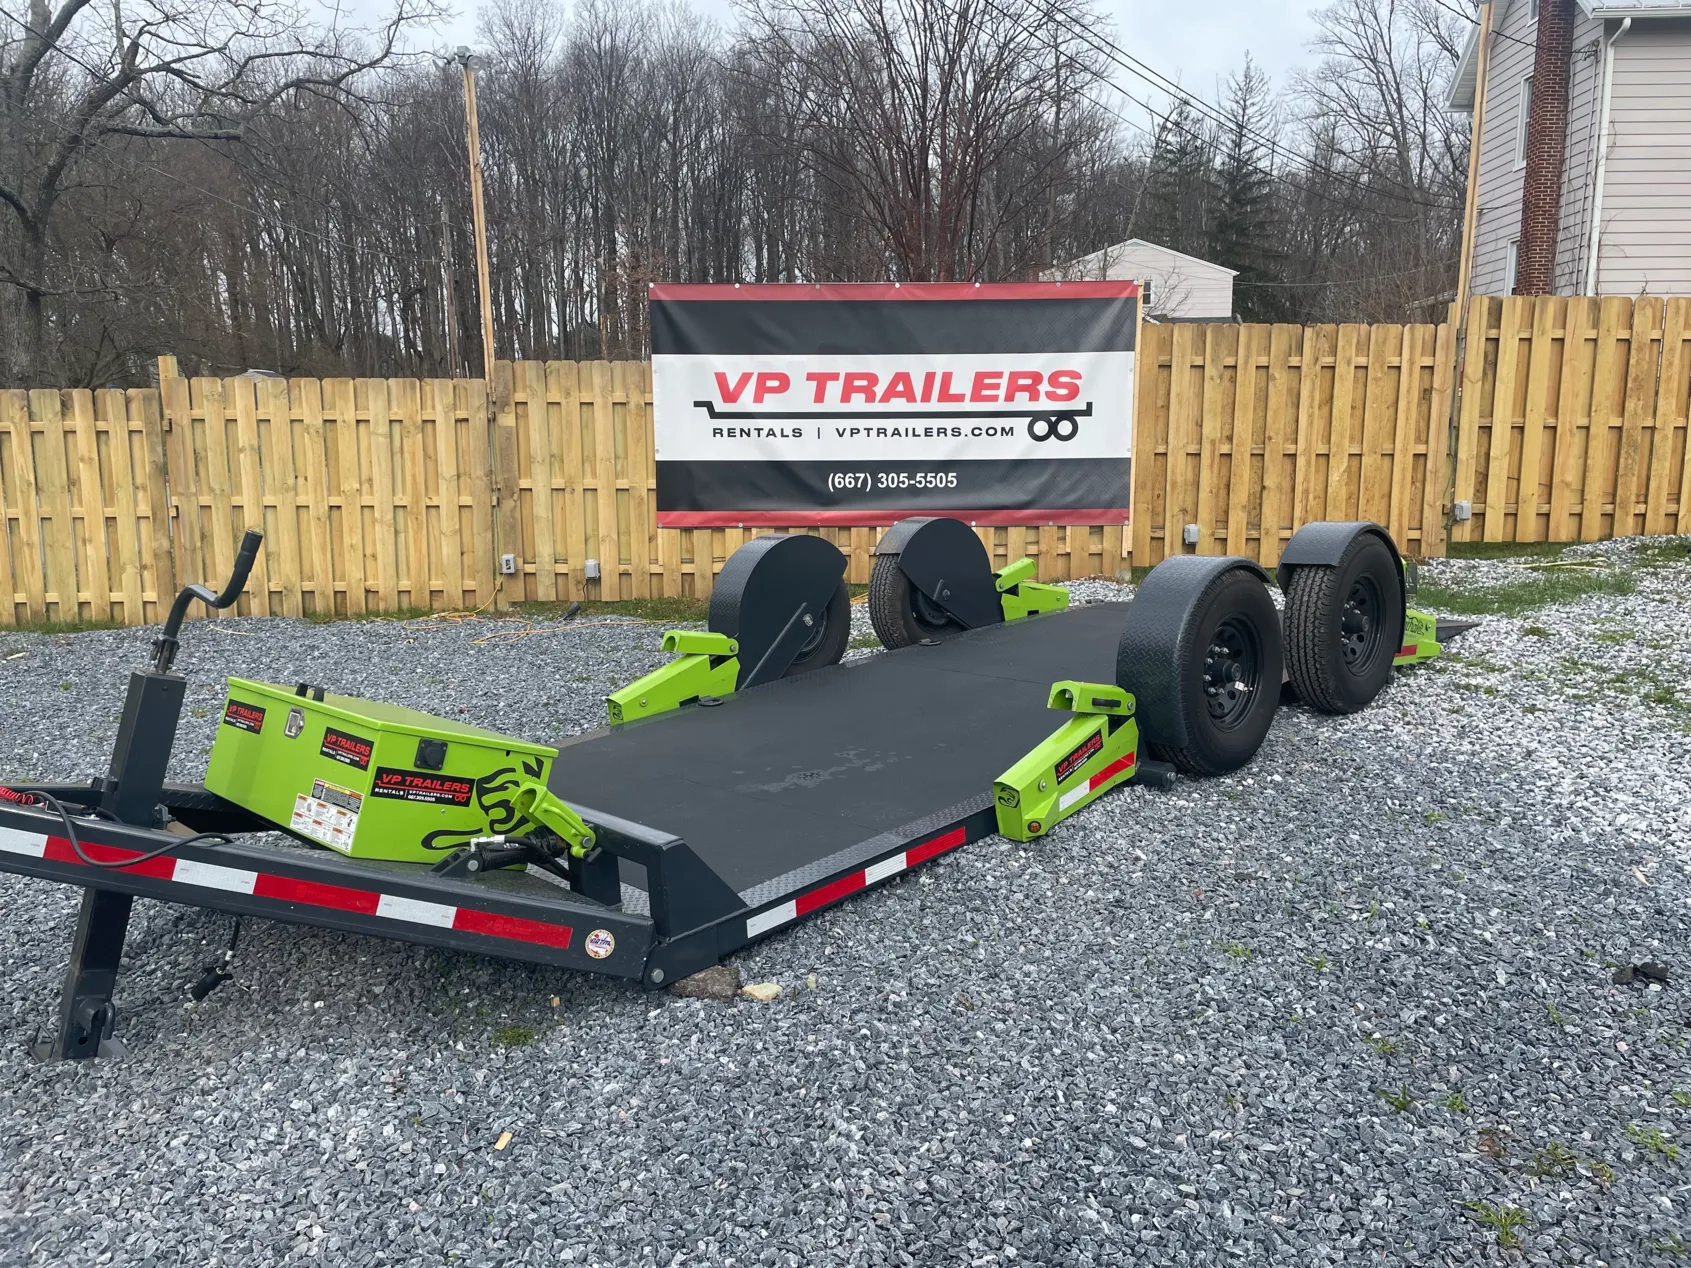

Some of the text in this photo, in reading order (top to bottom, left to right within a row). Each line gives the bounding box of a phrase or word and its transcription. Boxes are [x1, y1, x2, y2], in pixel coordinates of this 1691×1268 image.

[714, 369, 1083, 404] VP TRAILERS
[712, 427, 804, 438] RENTALS
[835, 426, 1015, 438] VPTRAILERS.COM
[828, 472, 958, 492] (667) 305-5505
[229, 705, 238, 713] VP
[237, 707, 264, 721] TRAILERS
[326, 733, 337, 743] VP
[337, 737, 371, 756] TRAILERS
[1058, 761, 1069, 773] VP
[1069, 734, 1101, 764] TRAILERS
[374, 787, 404, 796] RENTALS
[382, 773, 471, 793] VP TRAILERS
